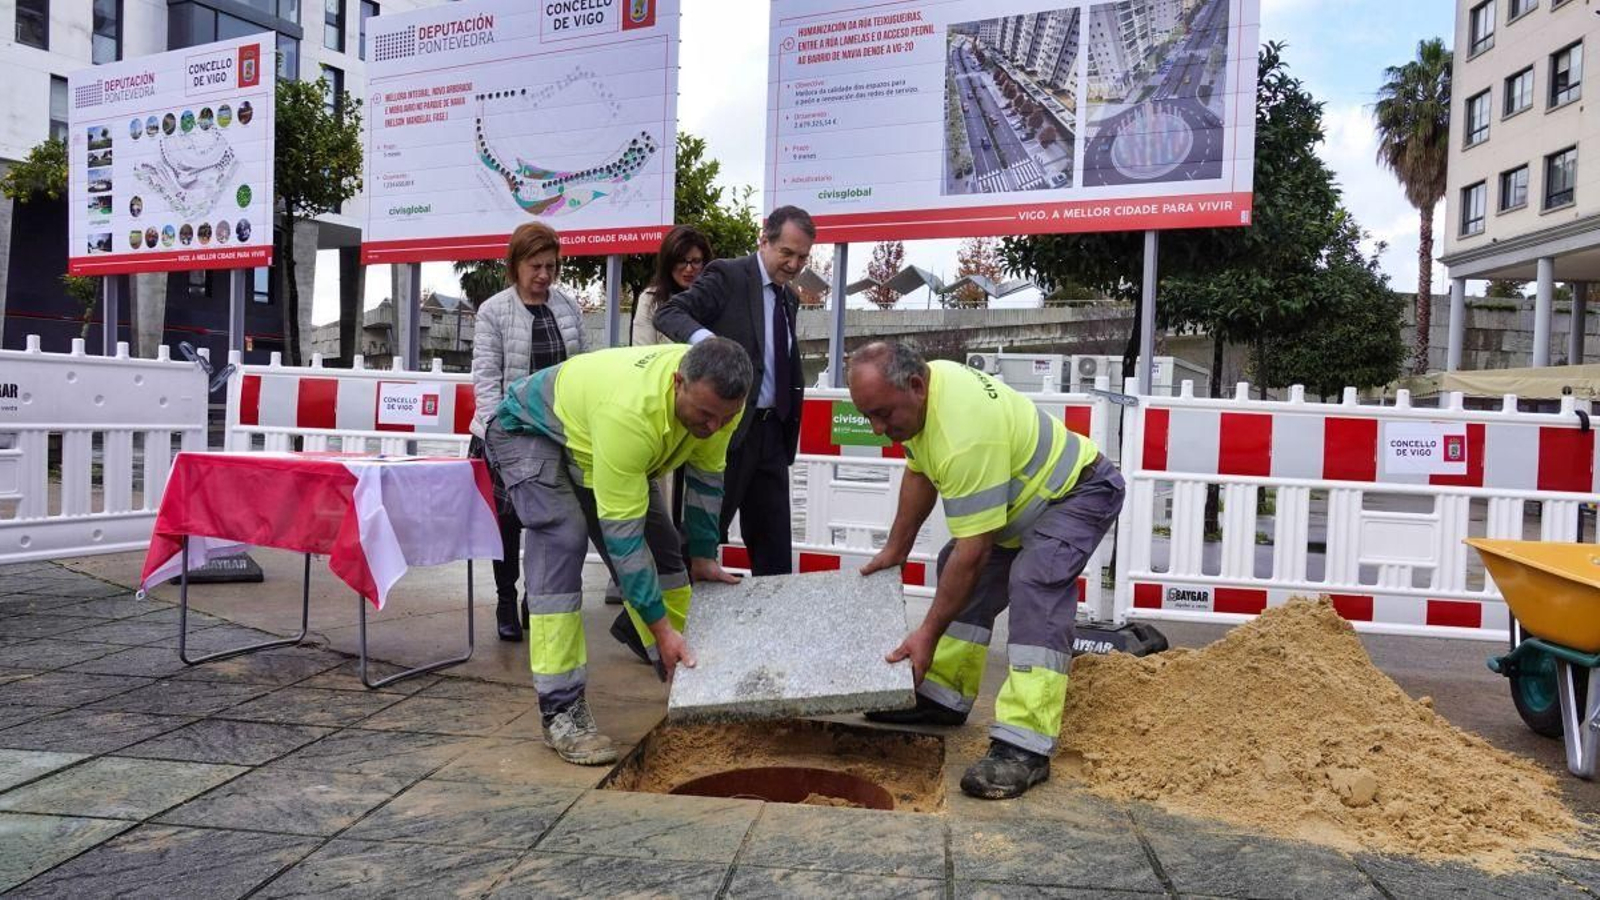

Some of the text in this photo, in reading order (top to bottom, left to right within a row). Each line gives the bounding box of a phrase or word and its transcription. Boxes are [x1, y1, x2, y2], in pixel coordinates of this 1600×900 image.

[546, 0, 612, 16] CONCELLO
[419, 12, 493, 40] DEPUTACIÓN
[553, 11, 604, 31] DE VIGO
[798, 20, 846, 37] HUMANIZACIÓN
[848, 20, 857, 30] DA
[858, 17, 872, 29] RÚA
[418, 31, 495, 54] PONTEVEDRA
[798, 39, 818, 51] ENTRE
[825, 36, 838, 48] RÚA
[839, 32, 870, 46] LAMELAS
[883, 28, 910, 40] ACCESO
[798, 56, 806, 64] AO
[807, 52, 831, 64] BARRIO
[831, 50, 840, 61] DE
[842, 48, 862, 59] NAVIA
[863, 44, 885, 57] DENDE
[892, 41, 914, 53] VG-20
[189, 58, 233, 75] CONCELLO
[105, 70, 155, 92] DEPUTACIÓN
[193, 71, 227, 87] DE VIGO
[105, 85, 155, 103] PONTEVEDRA
[818, 187, 872, 199] civisglobal
[389, 204, 431, 215] civisglobal
[1052, 209, 1060, 219] A
[1063, 207, 1111, 219] MELLOR
[1114, 204, 1158, 216] CIDADE
[1162, 203, 1194, 214] PARA
[1198, 200, 1233, 212] VIVIR
[587, 234, 616, 244] CIDADE
[618, 233, 638, 242] PARA
[640, 232, 662, 241] VIVIR
[383, 396, 418, 404] CONCELLO
[1390, 440, 1437, 448] CONCELLO
[1396, 448, 1432, 457] DE VIGO
